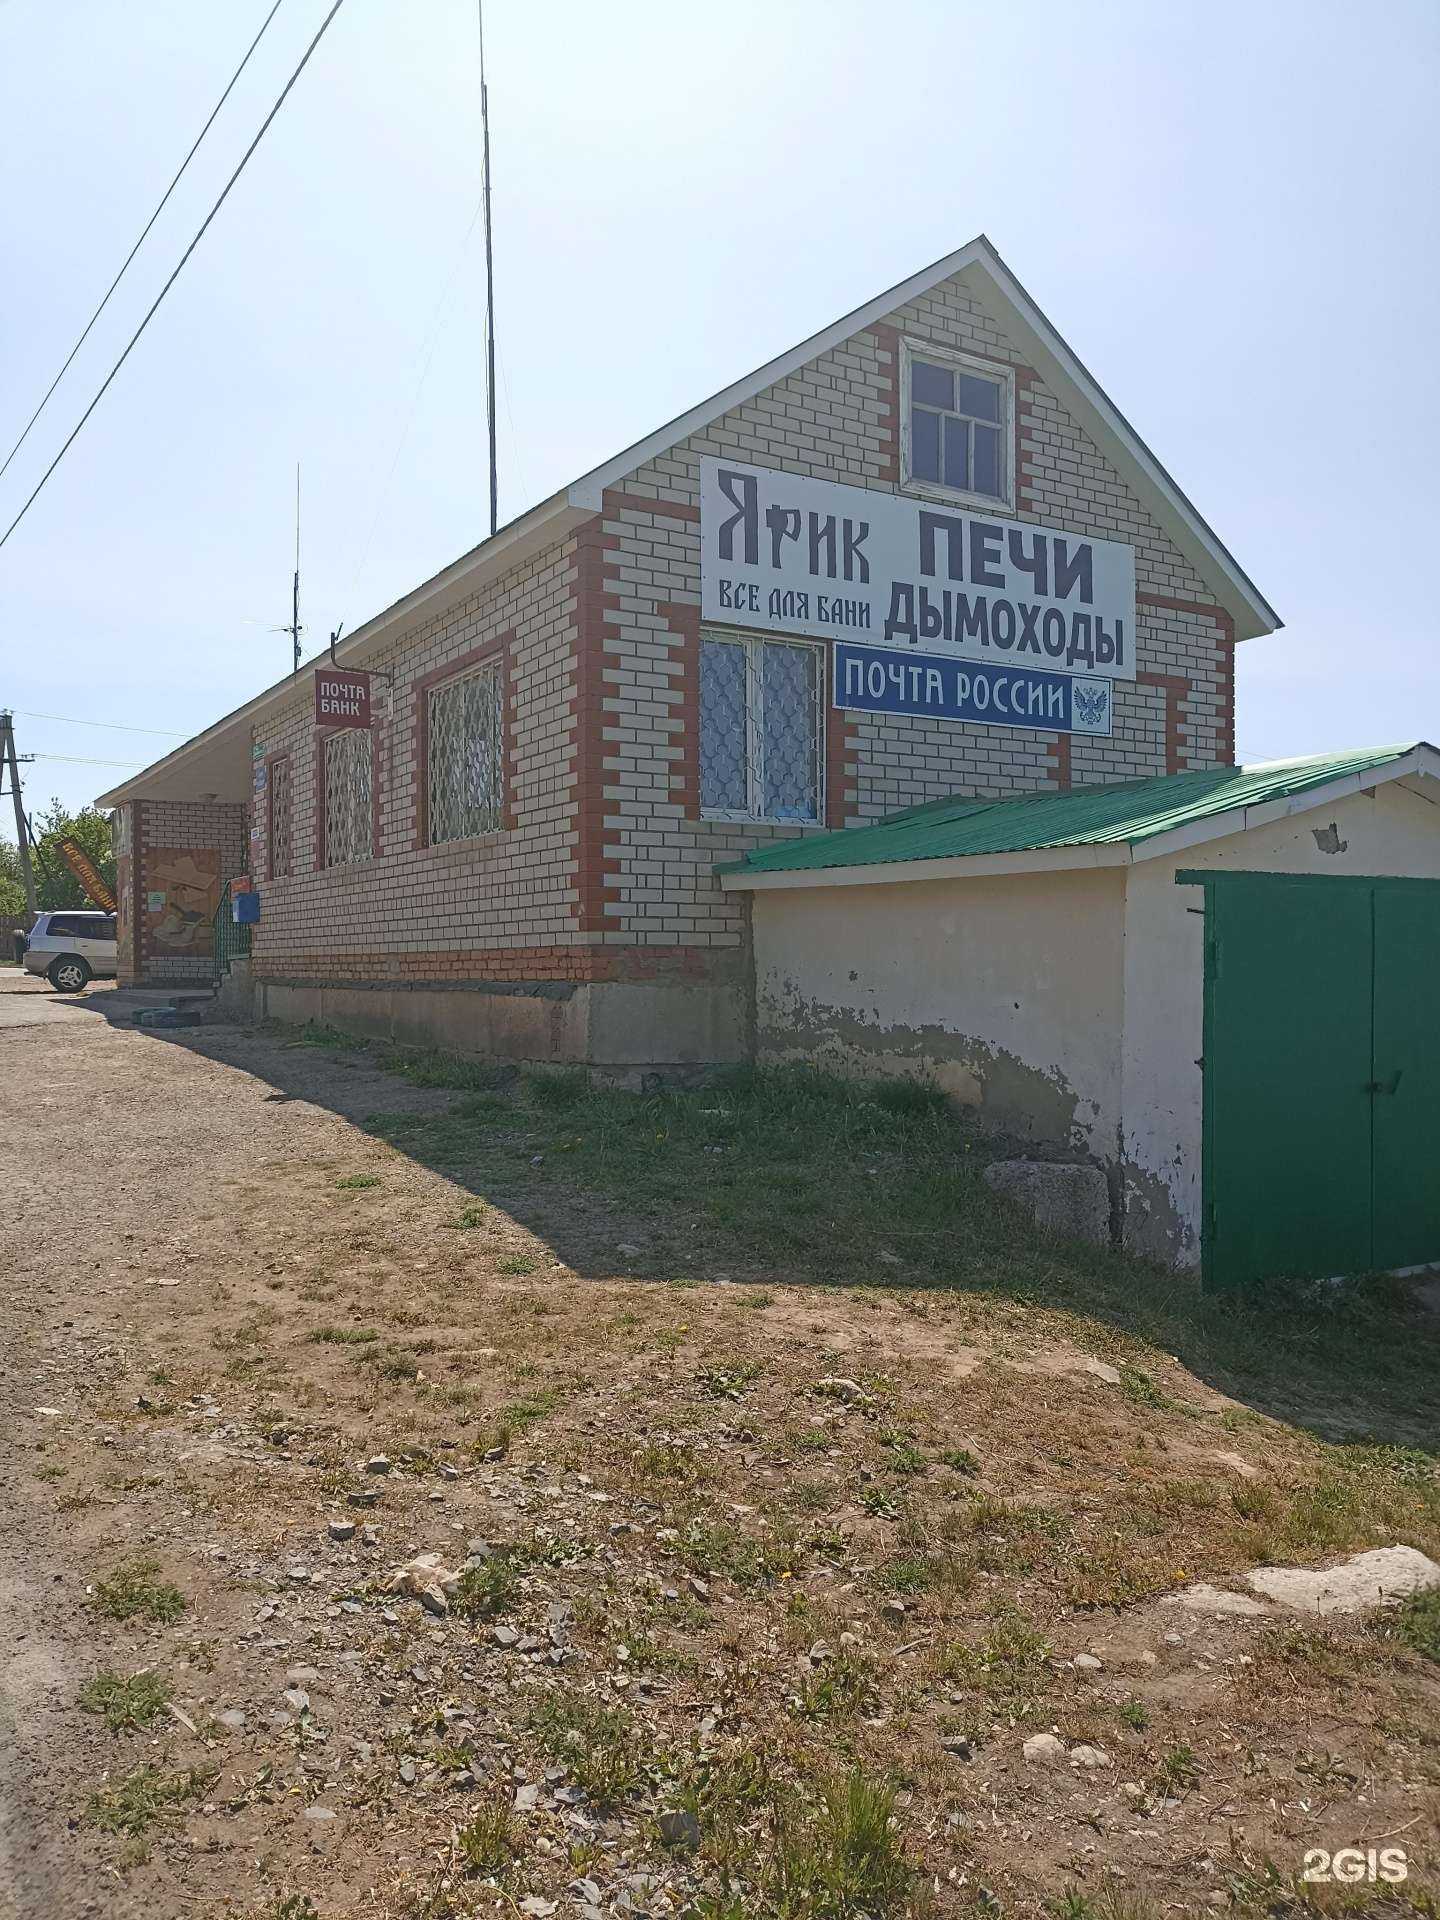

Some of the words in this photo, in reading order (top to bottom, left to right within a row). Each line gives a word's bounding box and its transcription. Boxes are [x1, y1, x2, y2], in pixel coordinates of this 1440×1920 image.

[919, 510, 1093, 604] ПЕЧИ
[719, 579, 760, 612] ВСЕ
[768, 588, 809, 620] ДЛЯ
[817, 595, 871, 628] БАНИ
[884, 581, 1123, 669] ДЫМОХОДЫ
[320, 682, 365, 700] ПОЧТА
[321, 699, 360, 716] БАНК
[845, 658, 944, 705] ПОЧТА
[957, 672, 1064, 718] РОССИИ
